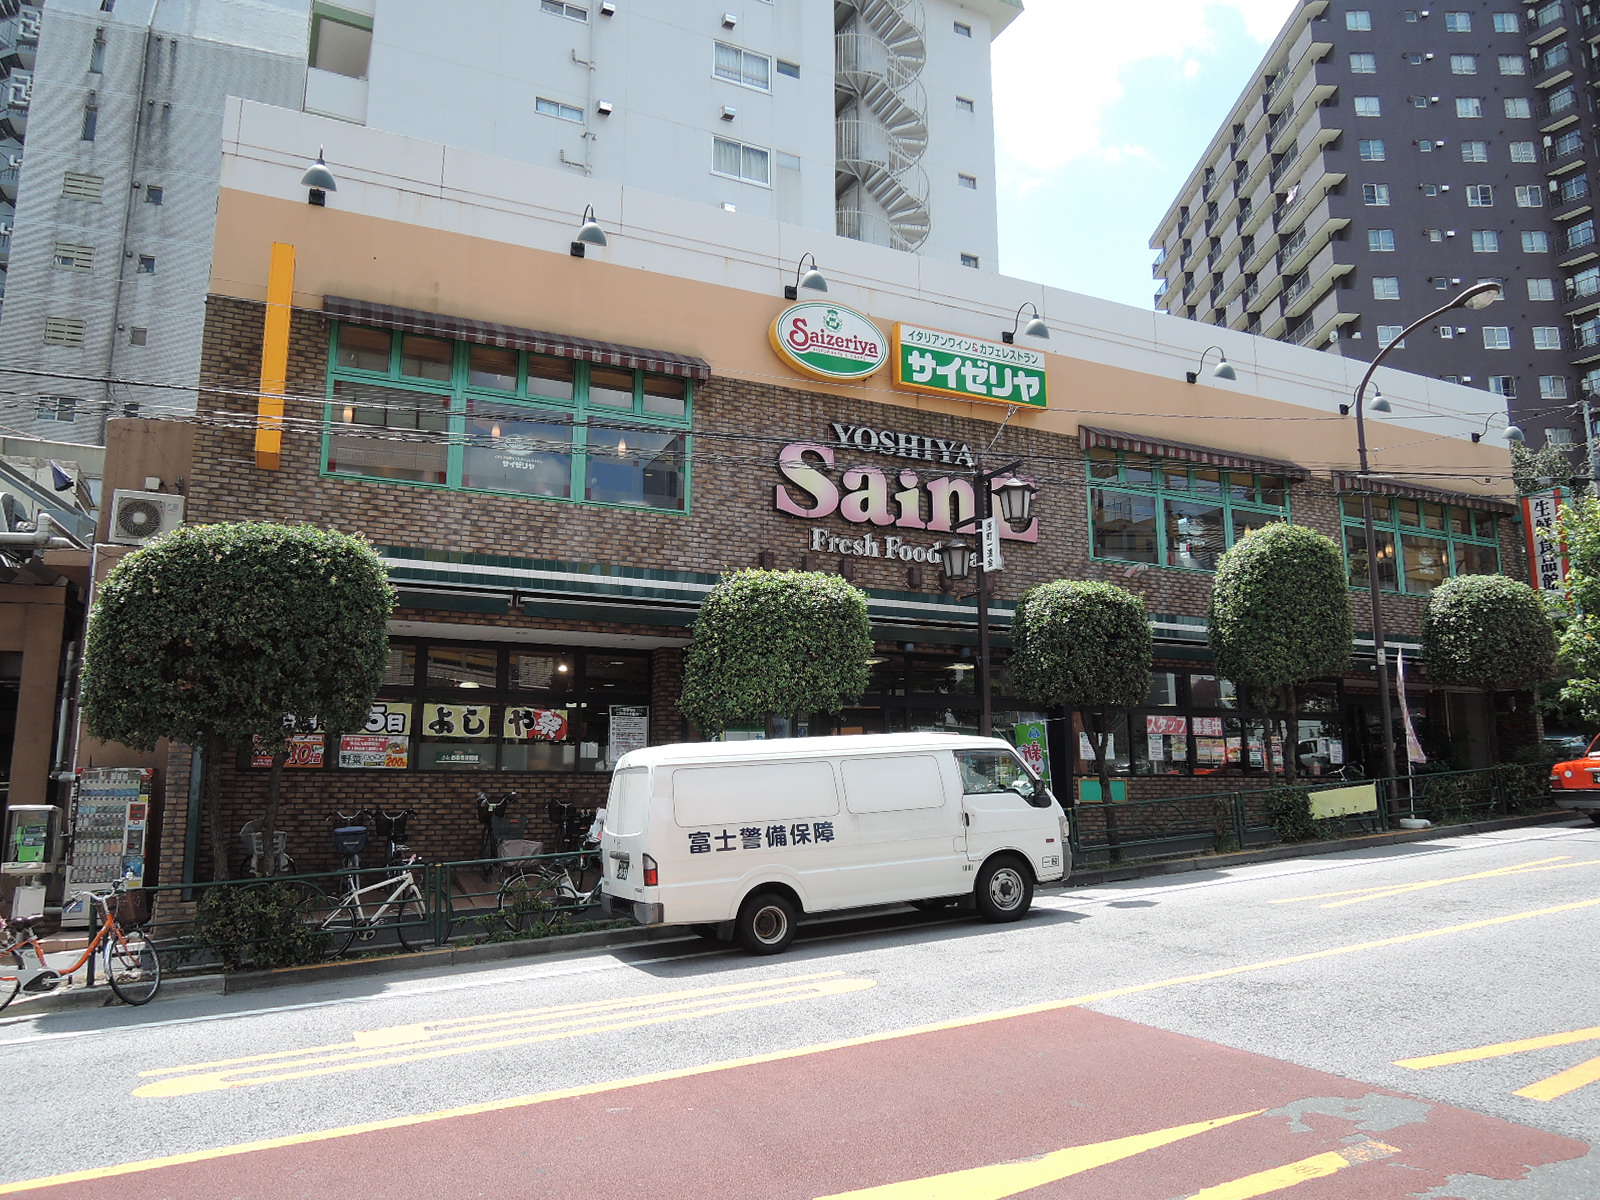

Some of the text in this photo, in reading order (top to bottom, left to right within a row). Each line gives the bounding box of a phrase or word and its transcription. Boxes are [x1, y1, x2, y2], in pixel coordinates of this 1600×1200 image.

[789, 317, 879, 355] Saizeriya
[908, 330, 1038, 364] イタリアンワイン&カフェレストラン
[907, 350, 1040, 402] サイゼリヤ
[831, 422, 975, 467] YOSHIYA
[810, 527, 880, 558] Fresh
[688, 821, 835, 854] 富士警備保障
